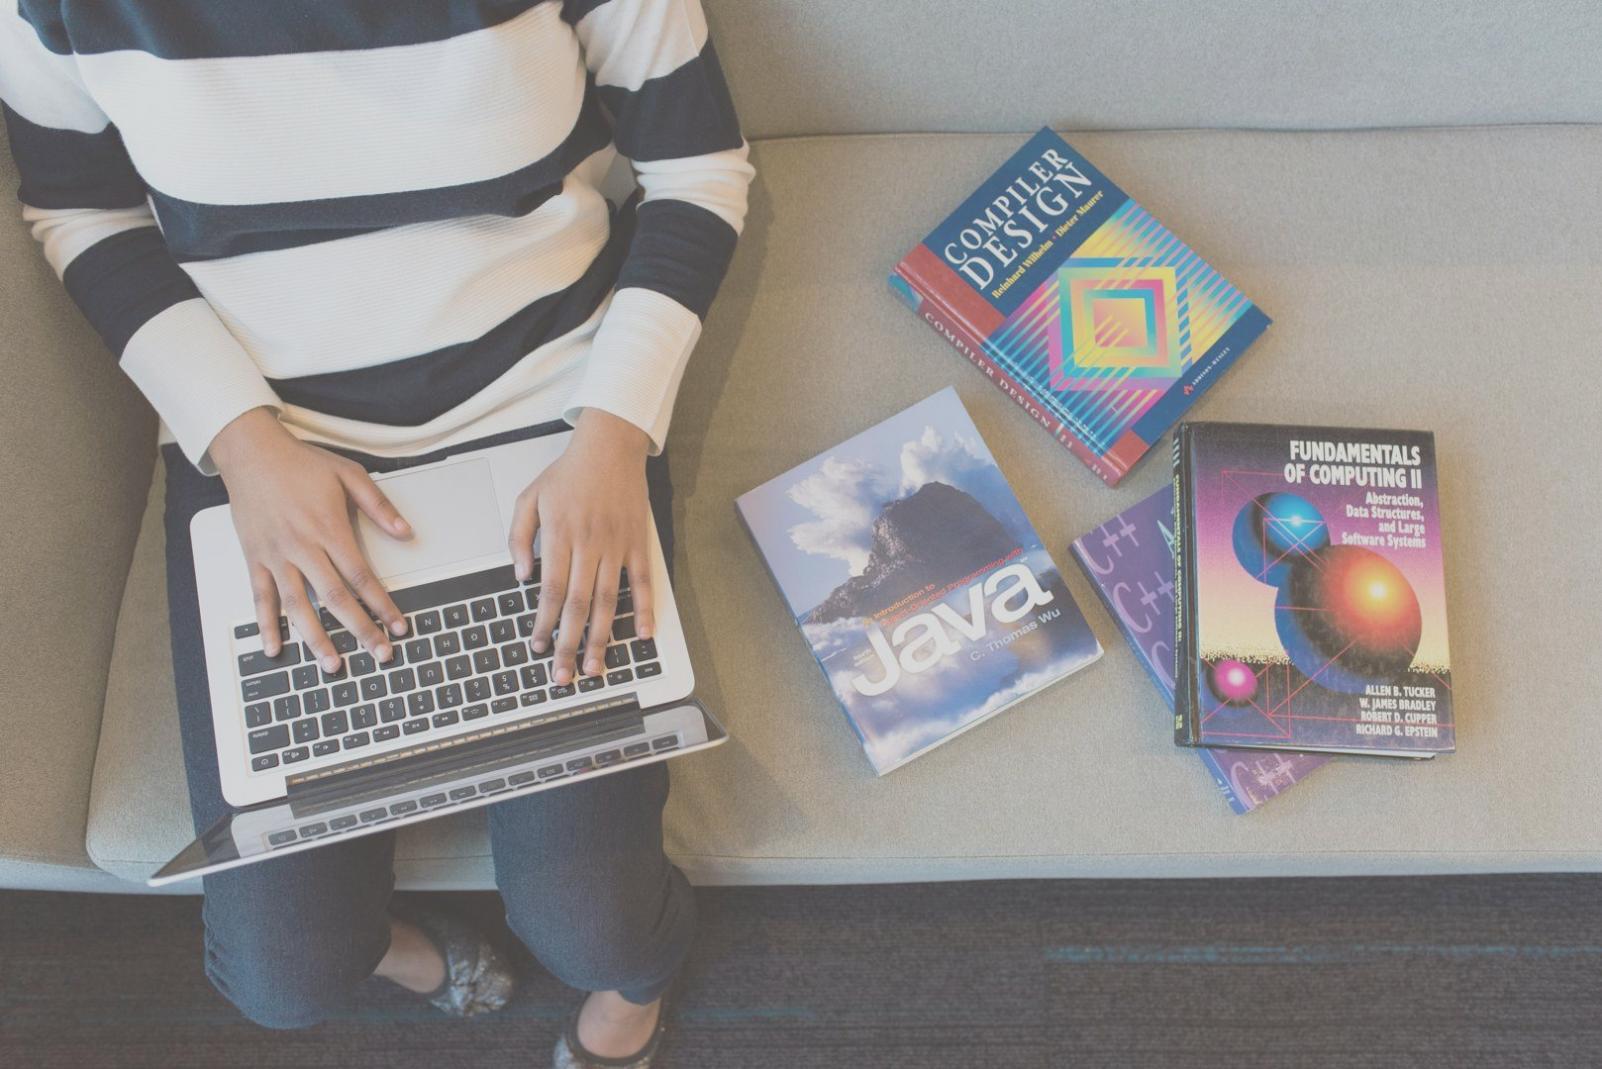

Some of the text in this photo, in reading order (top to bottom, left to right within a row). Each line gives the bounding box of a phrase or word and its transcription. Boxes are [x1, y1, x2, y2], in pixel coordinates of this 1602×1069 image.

[944, 149, 1068, 264] COMPILER
[959, 162, 1092, 290] DESIGN
[991, 190, 1104, 298] Reinhard Wilhelm Dieter Maurer
[925, 312, 1051, 428] COMPILER DESIGN
[1290, 440, 1421, 466] FUNDAMENTALS
[1284, 463, 1422, 489] OF COMPUTING II
[1365, 491, 1424, 508] Abstraction,
[1346, 504, 1425, 522] Data Structures,
[1341, 531, 1427, 550] Software Systems
[1378, 521, 1426, 537] and Large
[873, 589, 925, 619] Introduction
[925, 583, 936, 593] to
[1112, 571, 1175, 633] C++
[852, 563, 1054, 696] Java
[970, 608, 1061, 662] C. Thomas Wu
[1359, 698, 1436, 711] W. JAMES BRADLEY
[1365, 685, 1436, 698] ALLEN B. TUCKER
[1361, 711, 1437, 724] ROBERT D. CUPPER
[1356, 724, 1438, 738] RICHARD G. EPSTEIN
